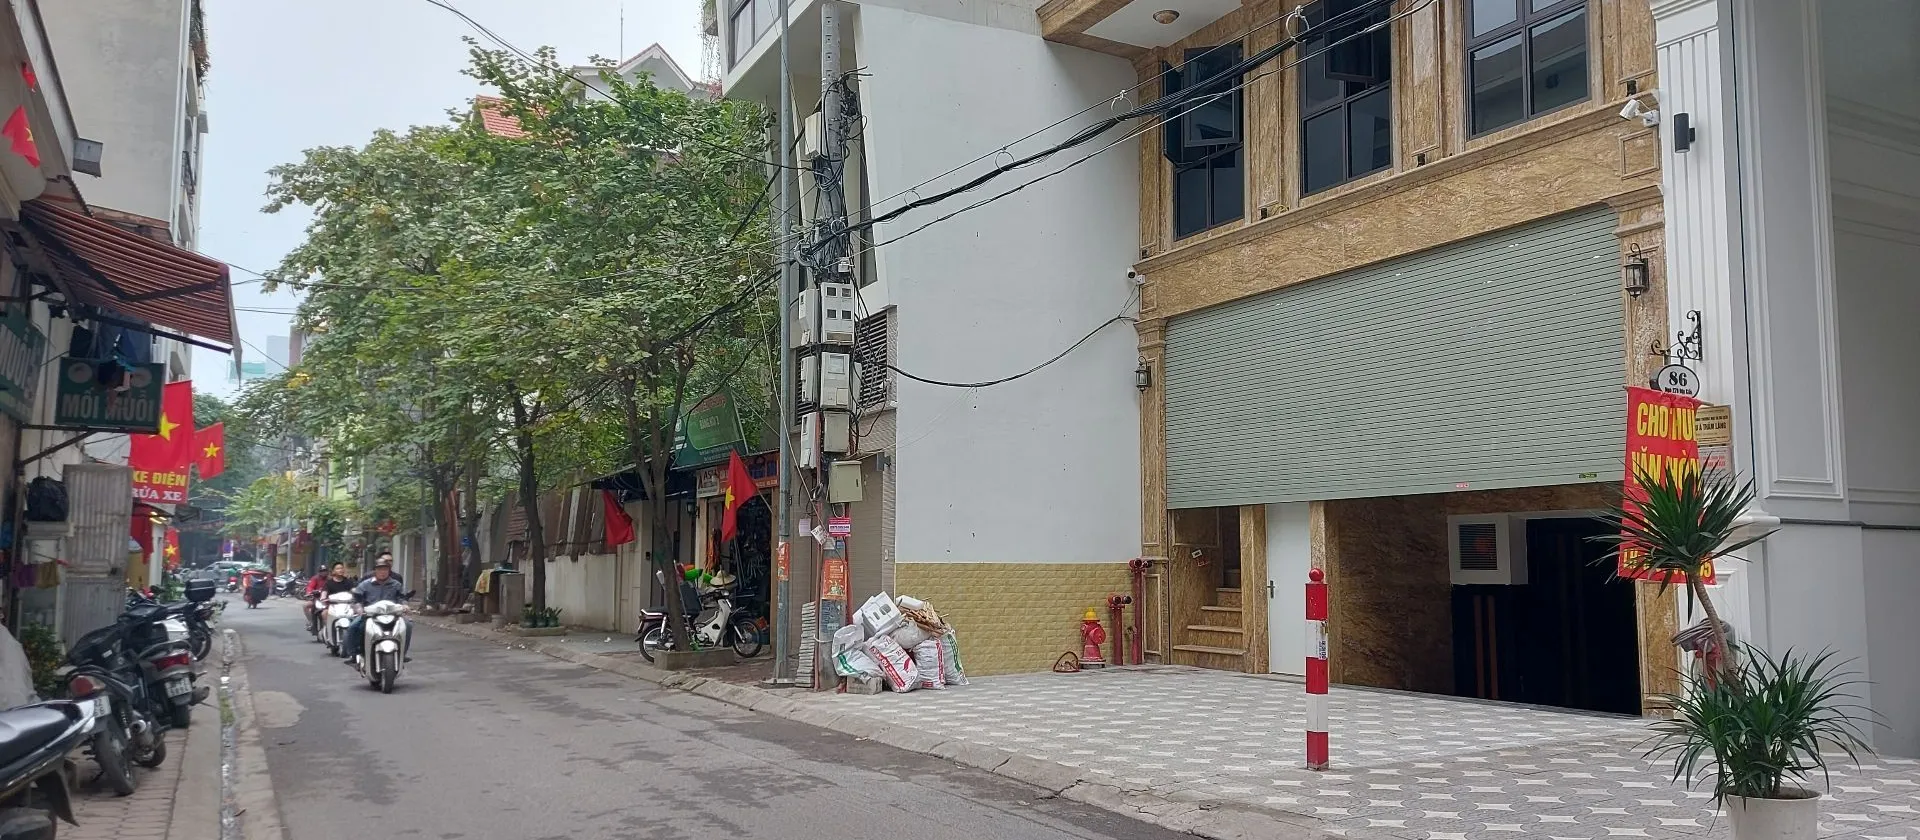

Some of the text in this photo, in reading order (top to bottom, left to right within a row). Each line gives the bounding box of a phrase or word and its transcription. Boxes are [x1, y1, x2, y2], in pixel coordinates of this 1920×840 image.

[1669, 371, 1688, 387] 86
[1637, 402, 1668, 438] CHO
[162, 490, 182, 501] XE
